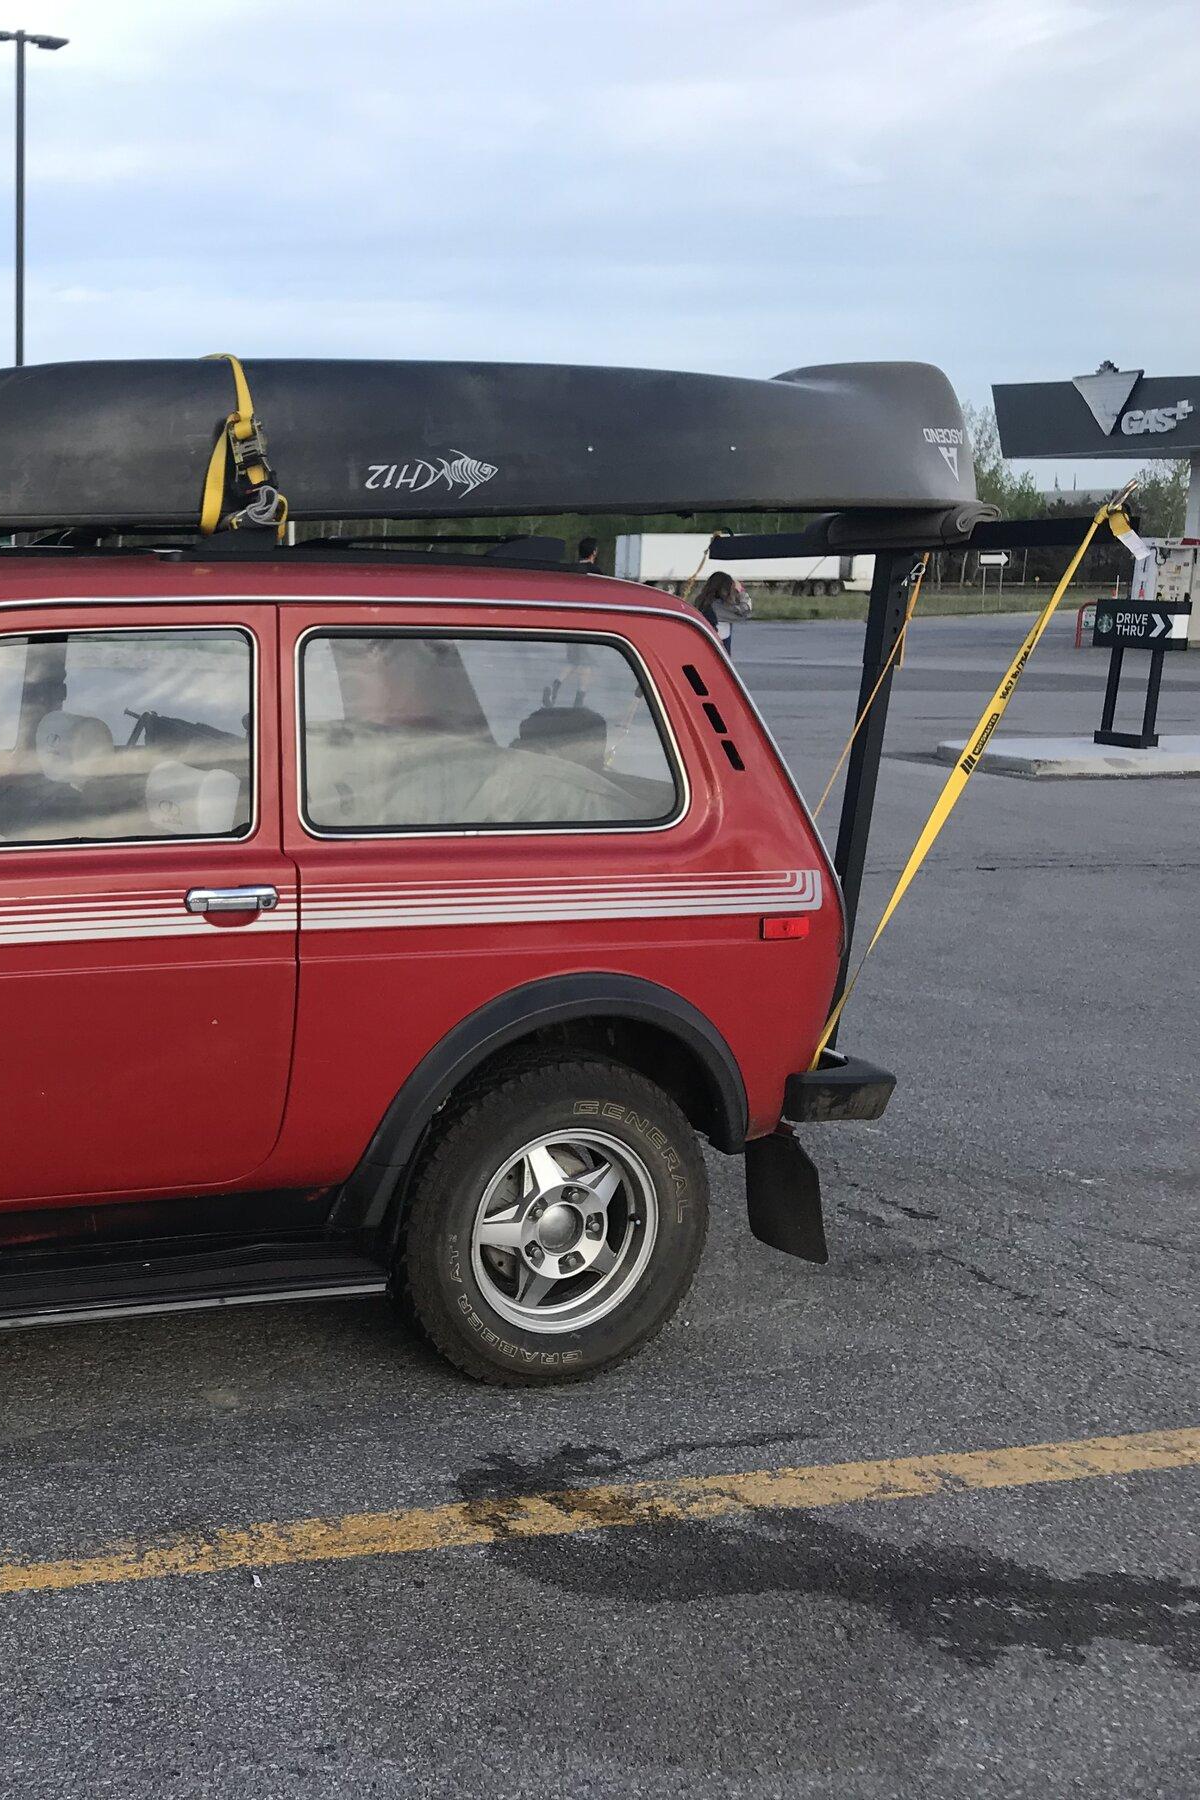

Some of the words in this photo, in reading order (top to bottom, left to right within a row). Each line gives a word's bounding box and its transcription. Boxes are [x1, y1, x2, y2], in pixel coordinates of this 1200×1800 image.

[922, 428, 964, 444] ASCEND
[364, 464, 423, 489] H12
[1116, 612, 1149, 626] DRIVE
[1116, 624, 1145, 637] THRU
[572, 1100, 689, 1224] GENERAL
[457, 1293, 583, 1365] GRABBER
